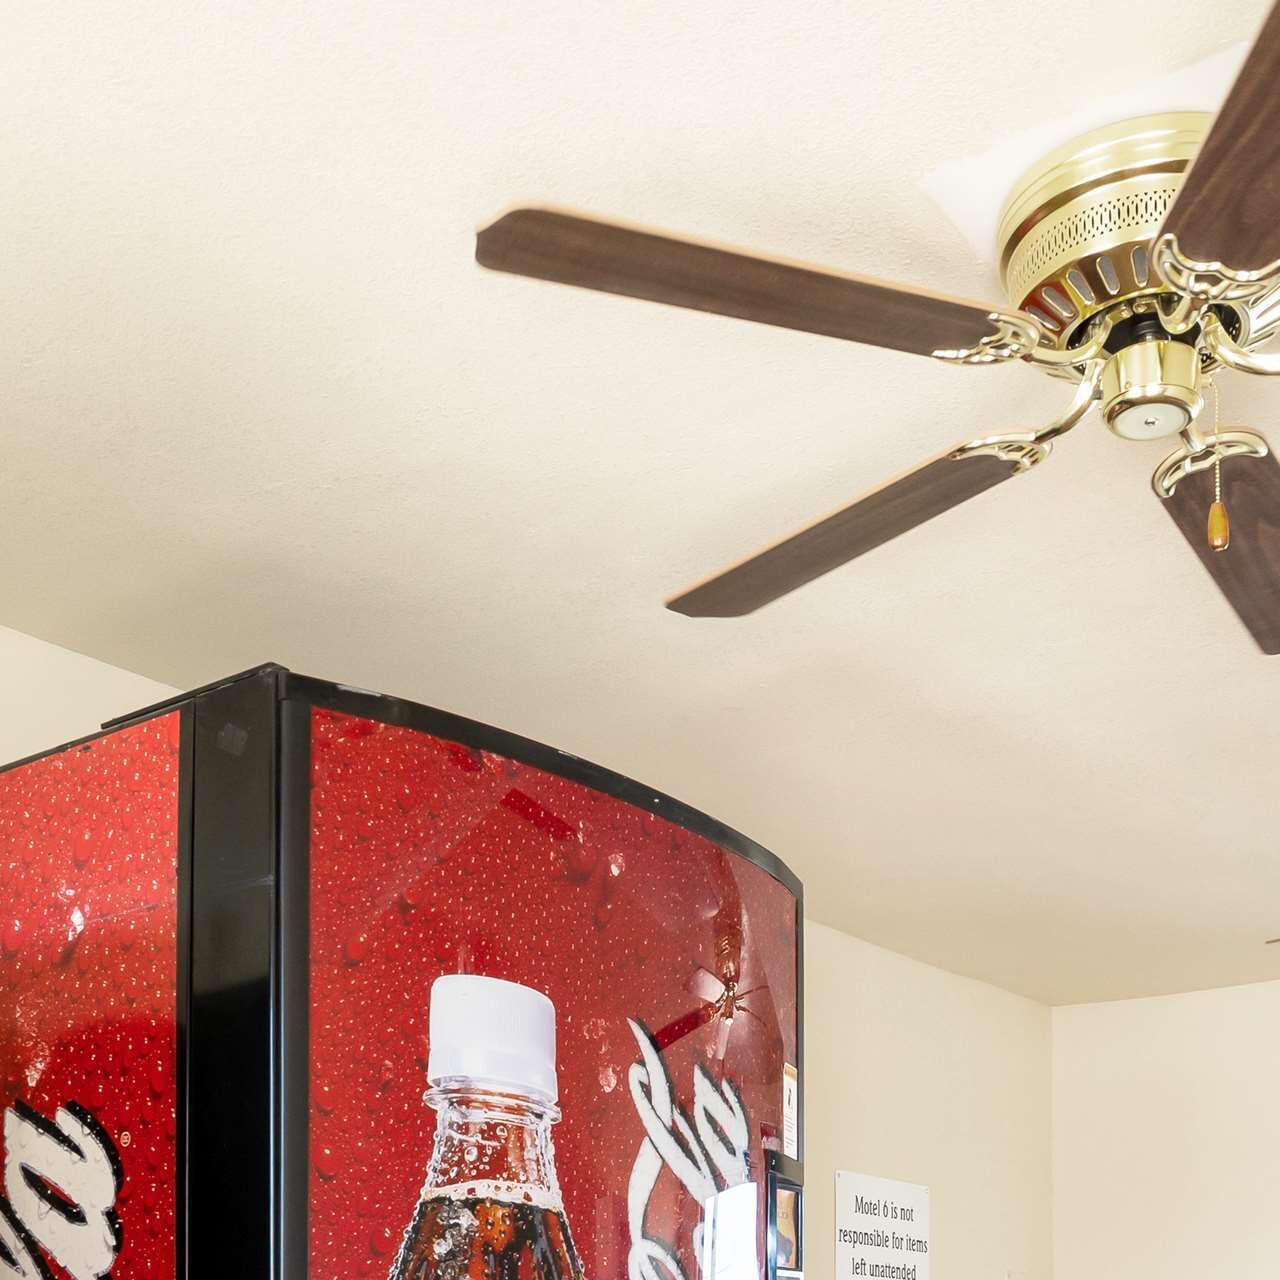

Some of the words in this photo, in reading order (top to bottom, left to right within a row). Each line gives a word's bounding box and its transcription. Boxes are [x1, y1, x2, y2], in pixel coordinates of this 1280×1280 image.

[855, 1194, 881, 1215] Motel
[882, 1200, 889, 1217] 6
[890, 1201, 898, 1218] is
[900, 1206, 914, 1221] not
[838, 1227, 890, 1248] responsible
[891, 1231, 904, 1249] for
[906, 1233, 928, 1252] items
[851, 1257, 867, 1275] left
[869, 1262, 917, 1280] unattended
